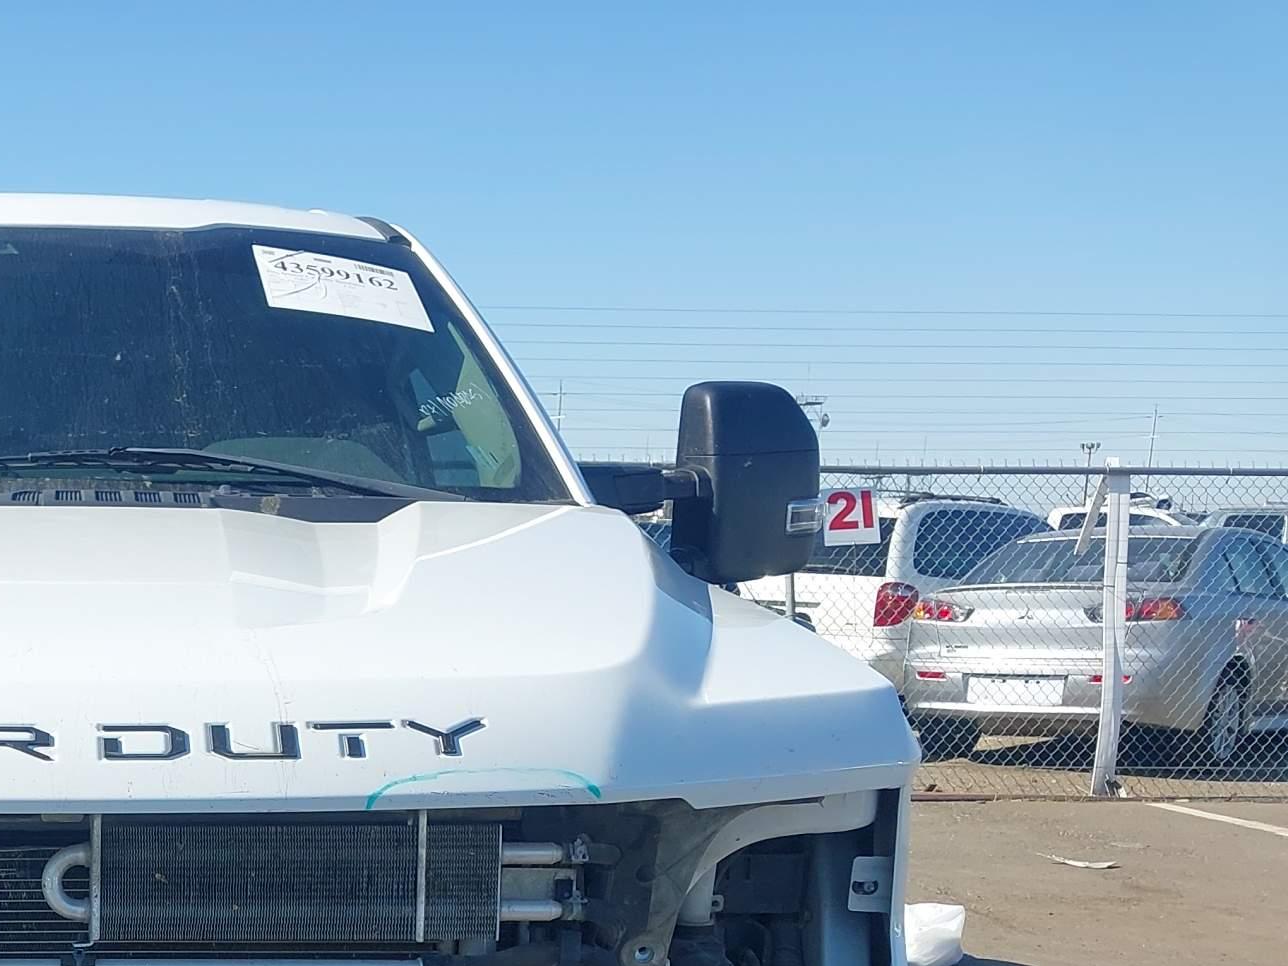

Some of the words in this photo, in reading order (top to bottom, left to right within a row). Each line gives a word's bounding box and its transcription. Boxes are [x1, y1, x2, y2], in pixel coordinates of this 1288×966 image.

[274, 261, 398, 290] 43599162
[827, 490, 874, 531] 21
[100, 717, 488, 761] DUTY
